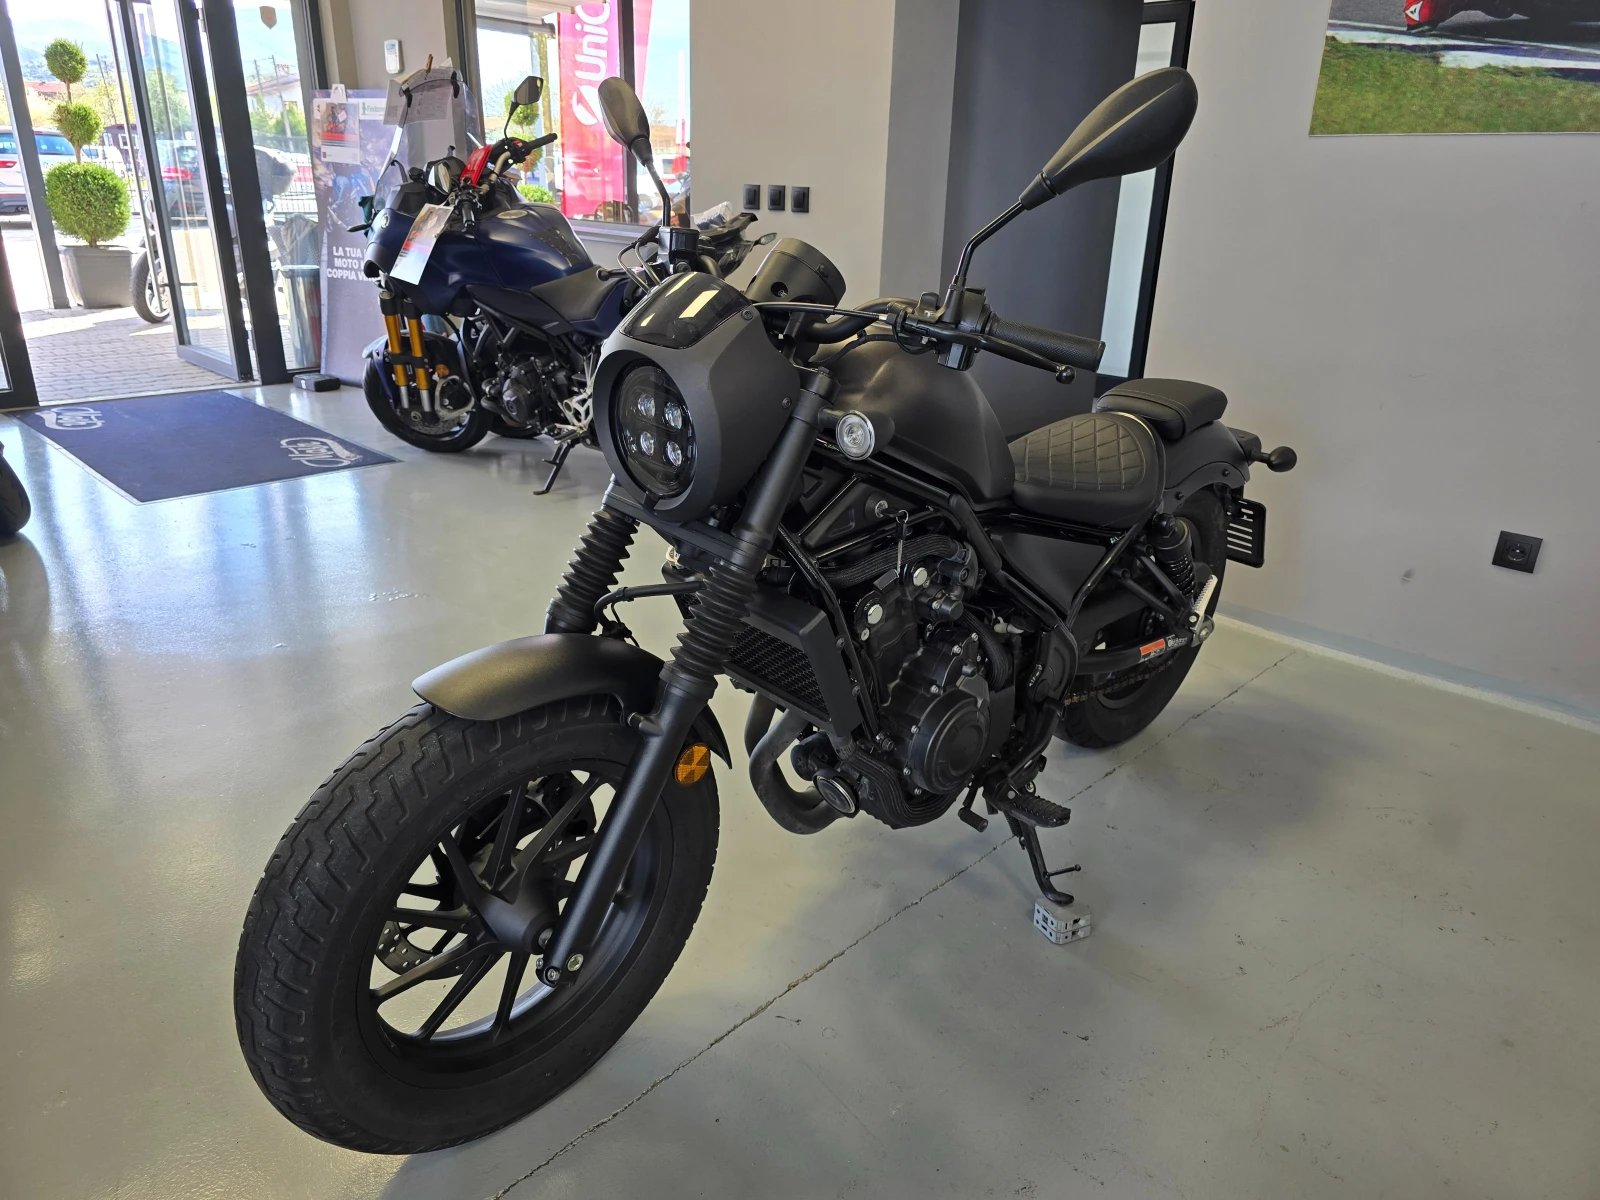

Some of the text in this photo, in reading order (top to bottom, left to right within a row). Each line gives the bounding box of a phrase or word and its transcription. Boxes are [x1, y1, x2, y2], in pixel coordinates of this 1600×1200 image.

[333, 246, 344, 257] LA
[345, 247, 363, 258] TUA
[334, 258, 359, 269] MOTO
[326, 268, 357, 281] COPPIA
